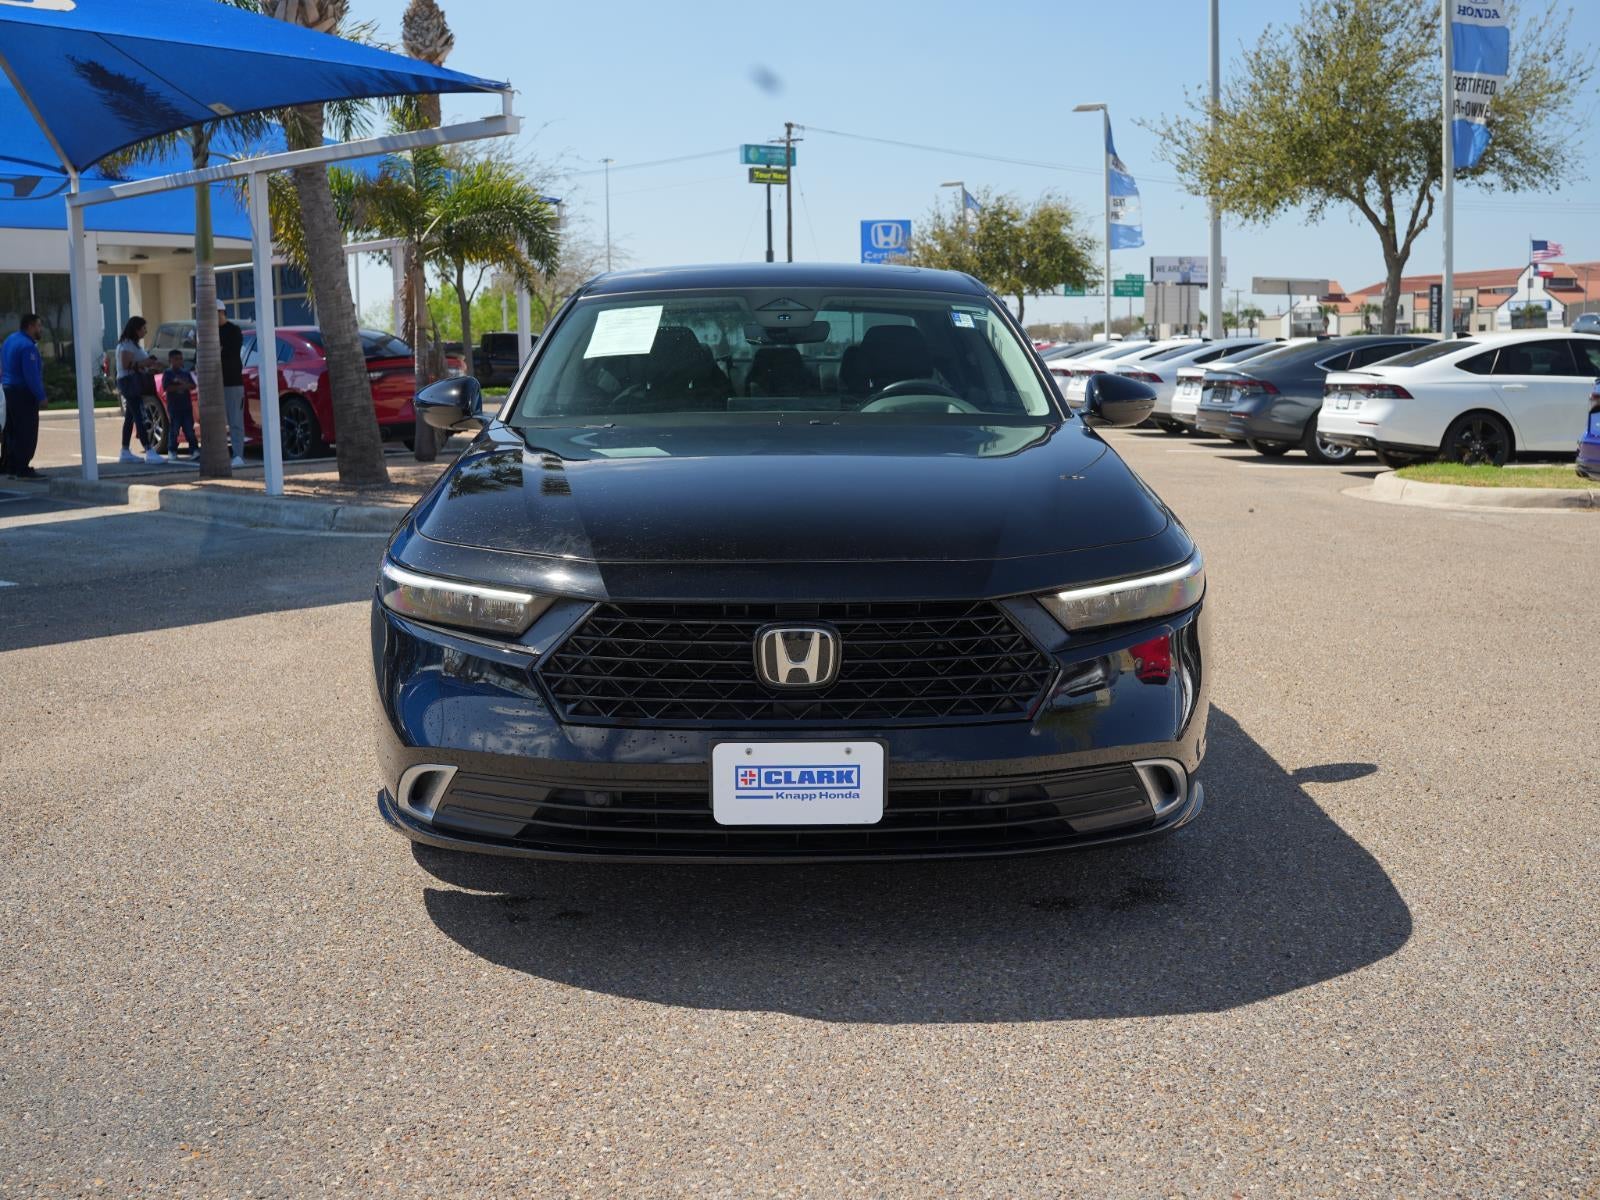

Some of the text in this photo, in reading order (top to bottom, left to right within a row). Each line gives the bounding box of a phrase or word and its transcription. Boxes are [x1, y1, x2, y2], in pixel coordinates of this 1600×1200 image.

[1457, 5, 1500, 19] HONDA
[764, 770, 855, 785] CLARK
[775, 791, 860, 801] Knapp Honda
